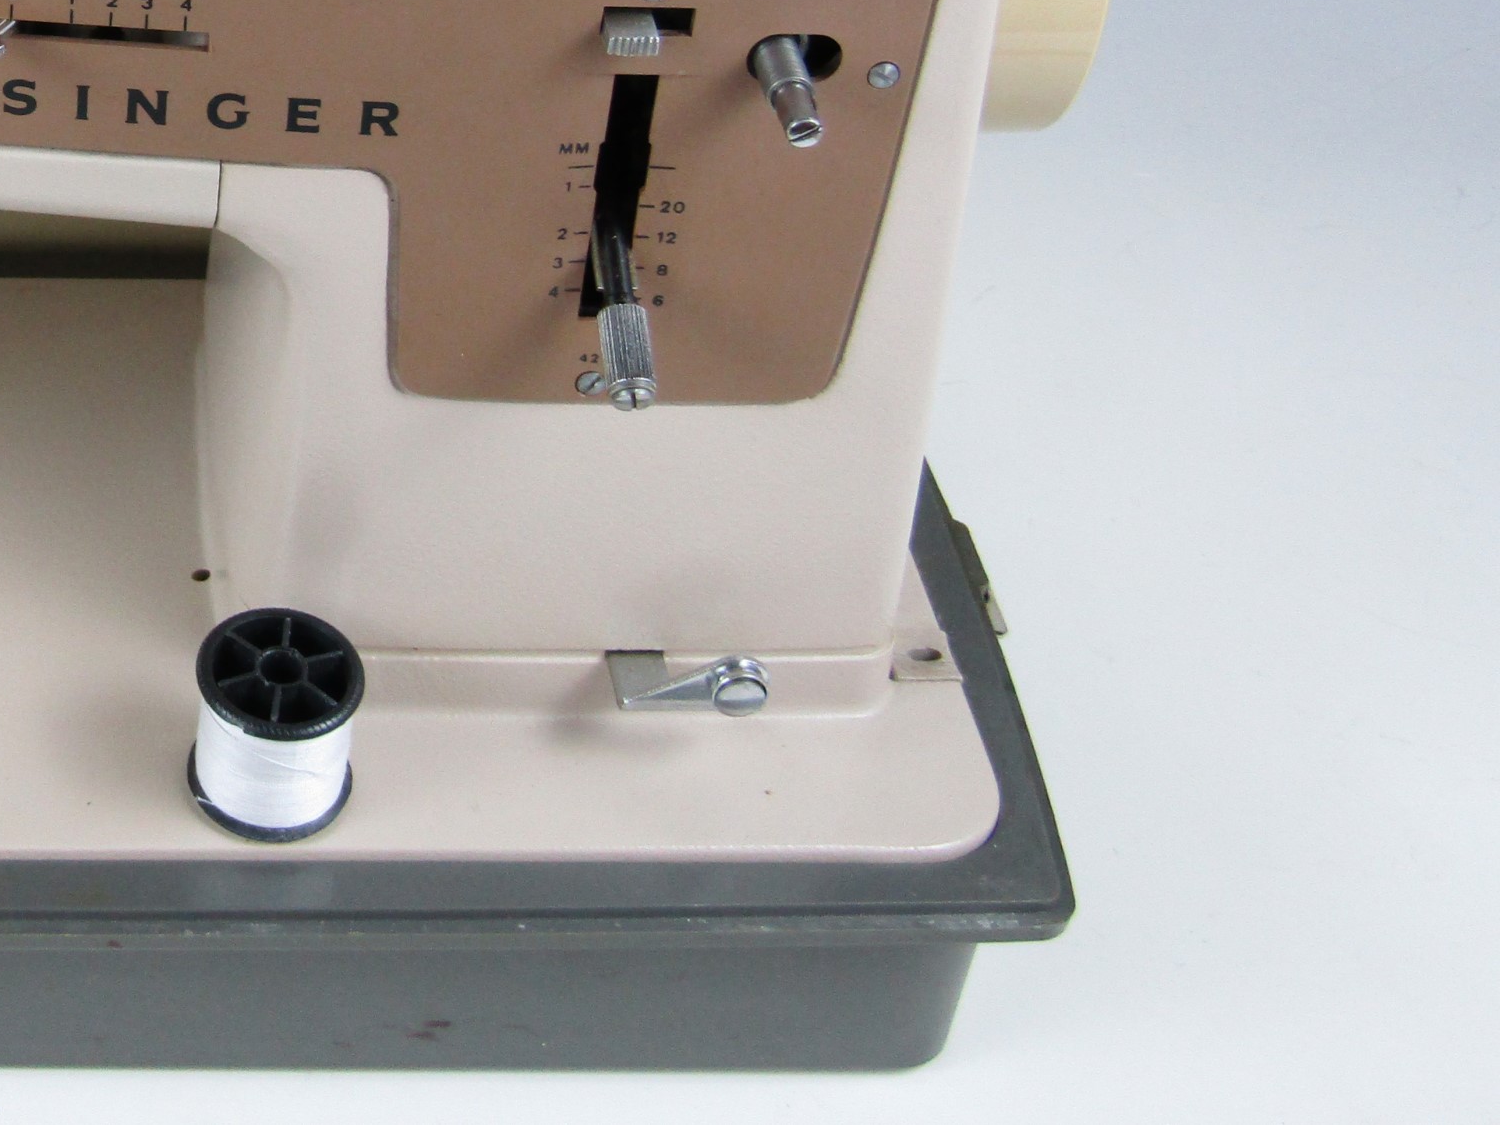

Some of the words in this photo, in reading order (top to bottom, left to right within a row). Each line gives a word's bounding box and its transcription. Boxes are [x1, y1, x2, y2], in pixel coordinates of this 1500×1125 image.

[2, 79, 400, 137] SINGER
[558, 142, 590, 155] MM
[565, 182, 571, 192] 1
[659, 201, 686, 214] 20
[557, 228, 568, 240] 2
[657, 232, 677, 244] 12
[552, 257, 563, 269] 3
[656, 265, 668, 276] 8
[548, 286, 559, 298] 4
[652, 295, 664, 307] 6
